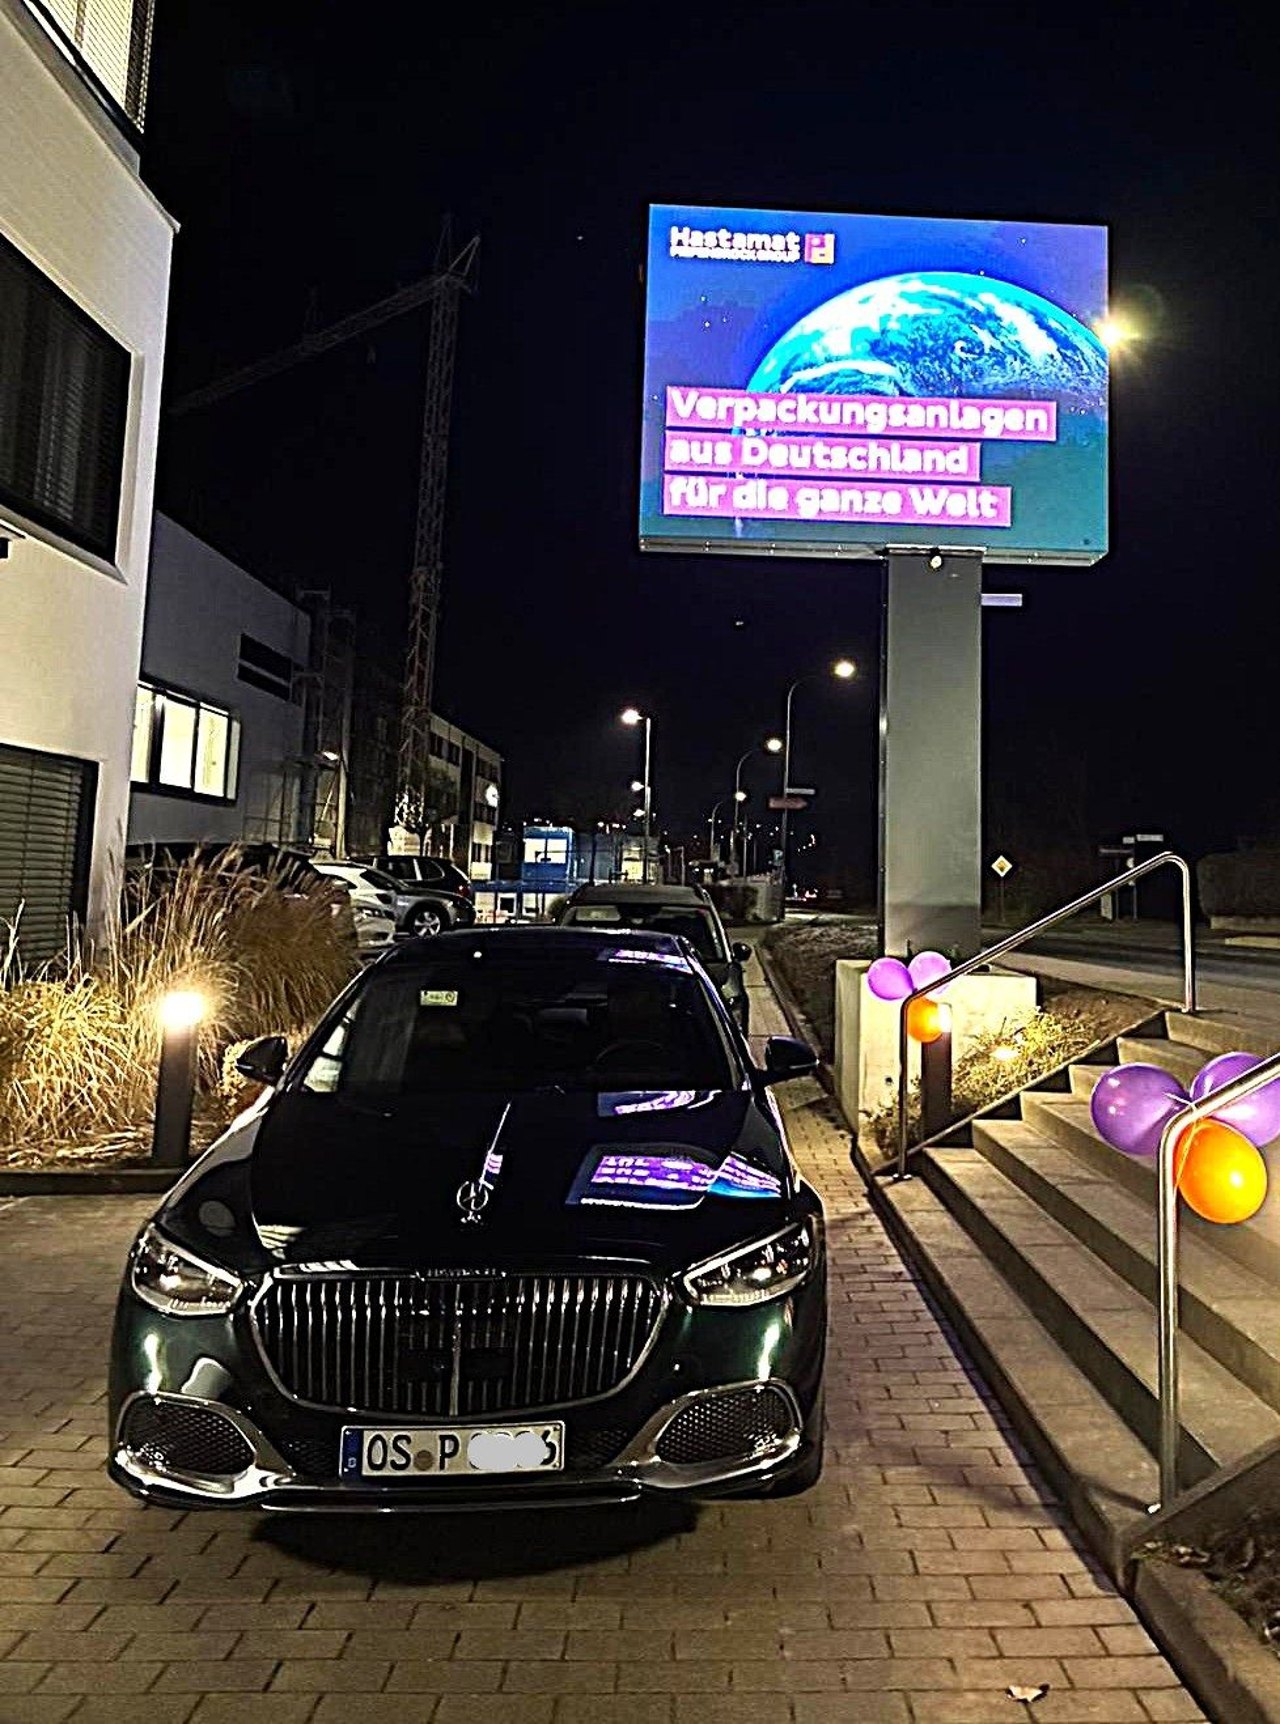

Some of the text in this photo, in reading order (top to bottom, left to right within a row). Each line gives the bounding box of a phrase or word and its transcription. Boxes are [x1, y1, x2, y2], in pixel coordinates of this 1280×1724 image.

[670, 226, 801, 250] Hastamat
[670, 388, 1048, 437] Verpackungsanlagen
[669, 437, 969, 474] aus Deutschland
[669, 475, 998, 519] für die ganze Welt
[367, 1433, 412, 1471] OS
[438, 1434, 460, 1471] P
